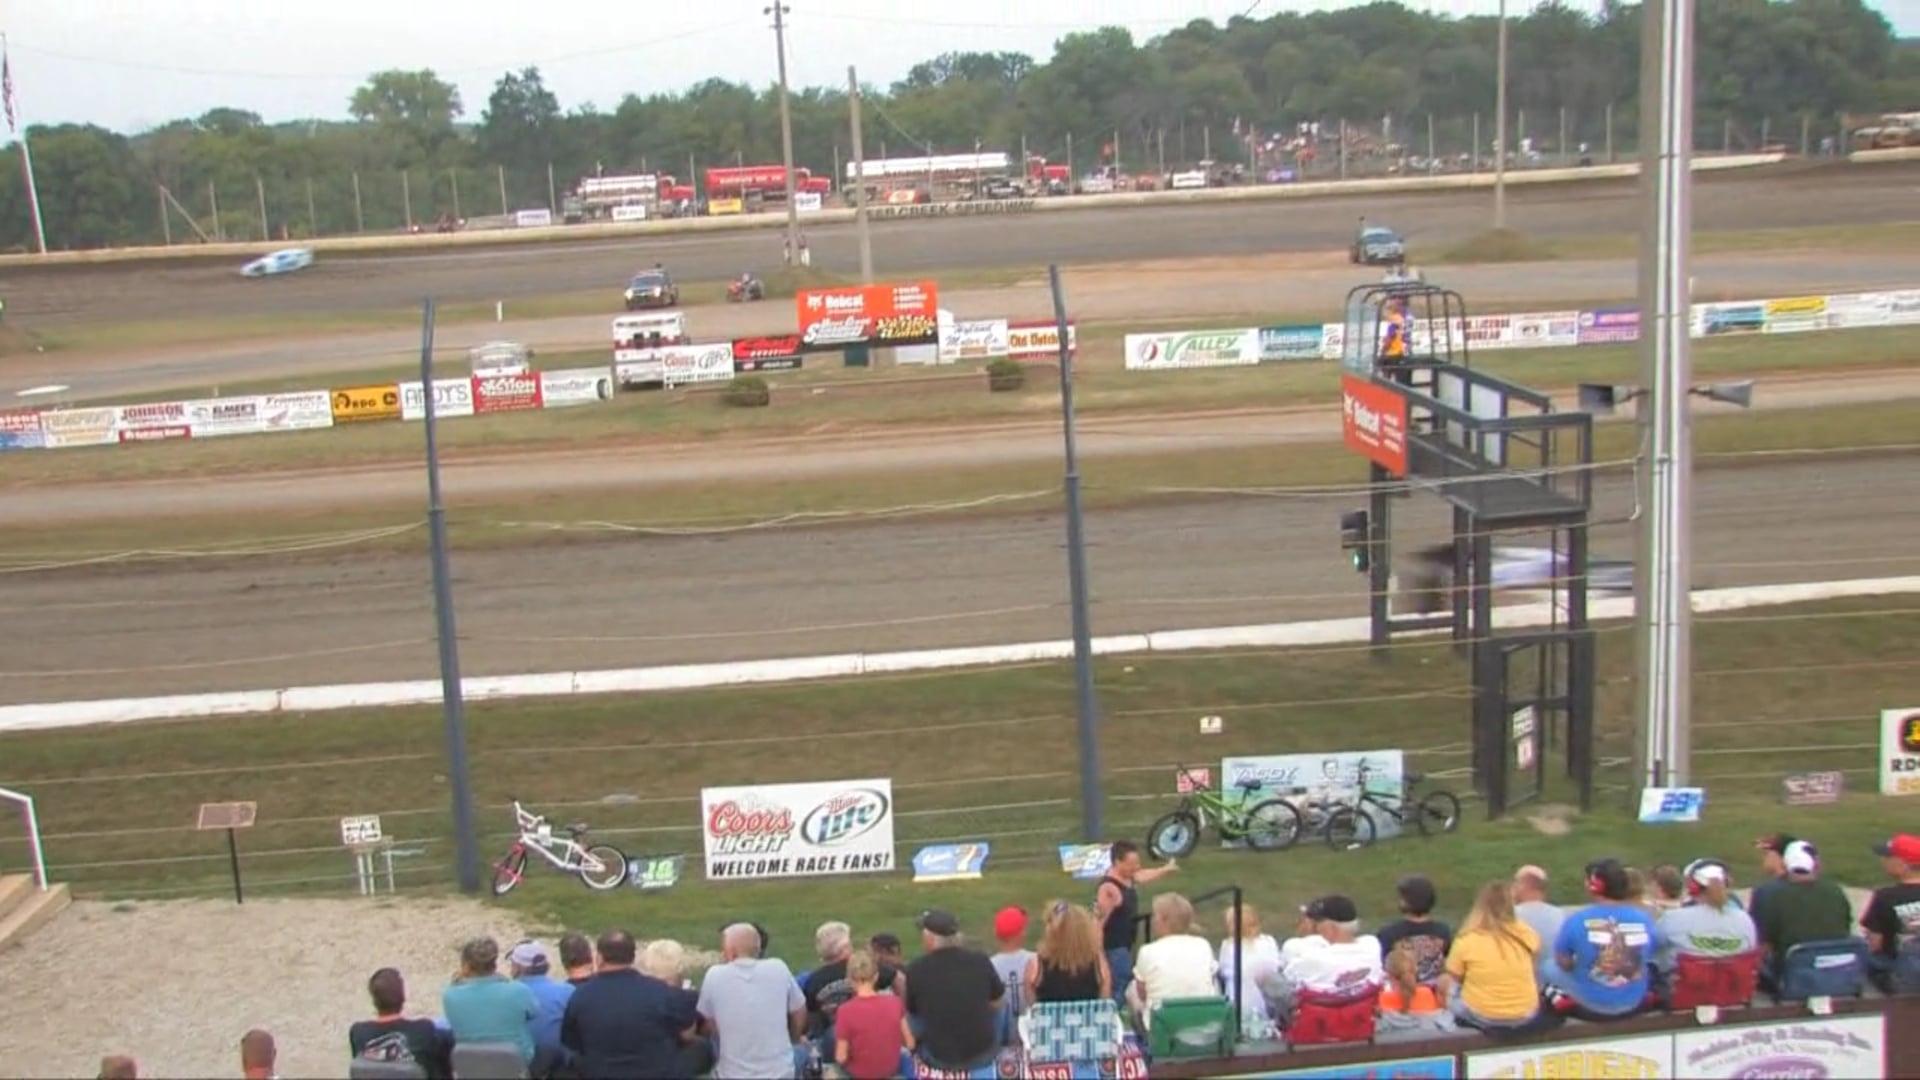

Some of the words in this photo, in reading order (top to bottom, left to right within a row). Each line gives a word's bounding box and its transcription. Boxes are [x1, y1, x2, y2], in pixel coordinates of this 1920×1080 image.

[864, 203, 894, 219] EER
[897, 202, 949, 219] CREEK
[955, 200, 1034, 215] SPEEDWAY
[1010, 333, 1027, 346] Old
[1157, 336, 1238, 361] VALLEY
[120, 404, 184, 420] JOHNSON
[1891, 759, 1920, 772] RD
[708, 800, 795, 837] Coors
[714, 832, 790, 855] LIGHT
[711, 859, 790, 876] WELCOME
[795, 855, 836, 871] RACE
[842, 853, 889, 869] FANS!
